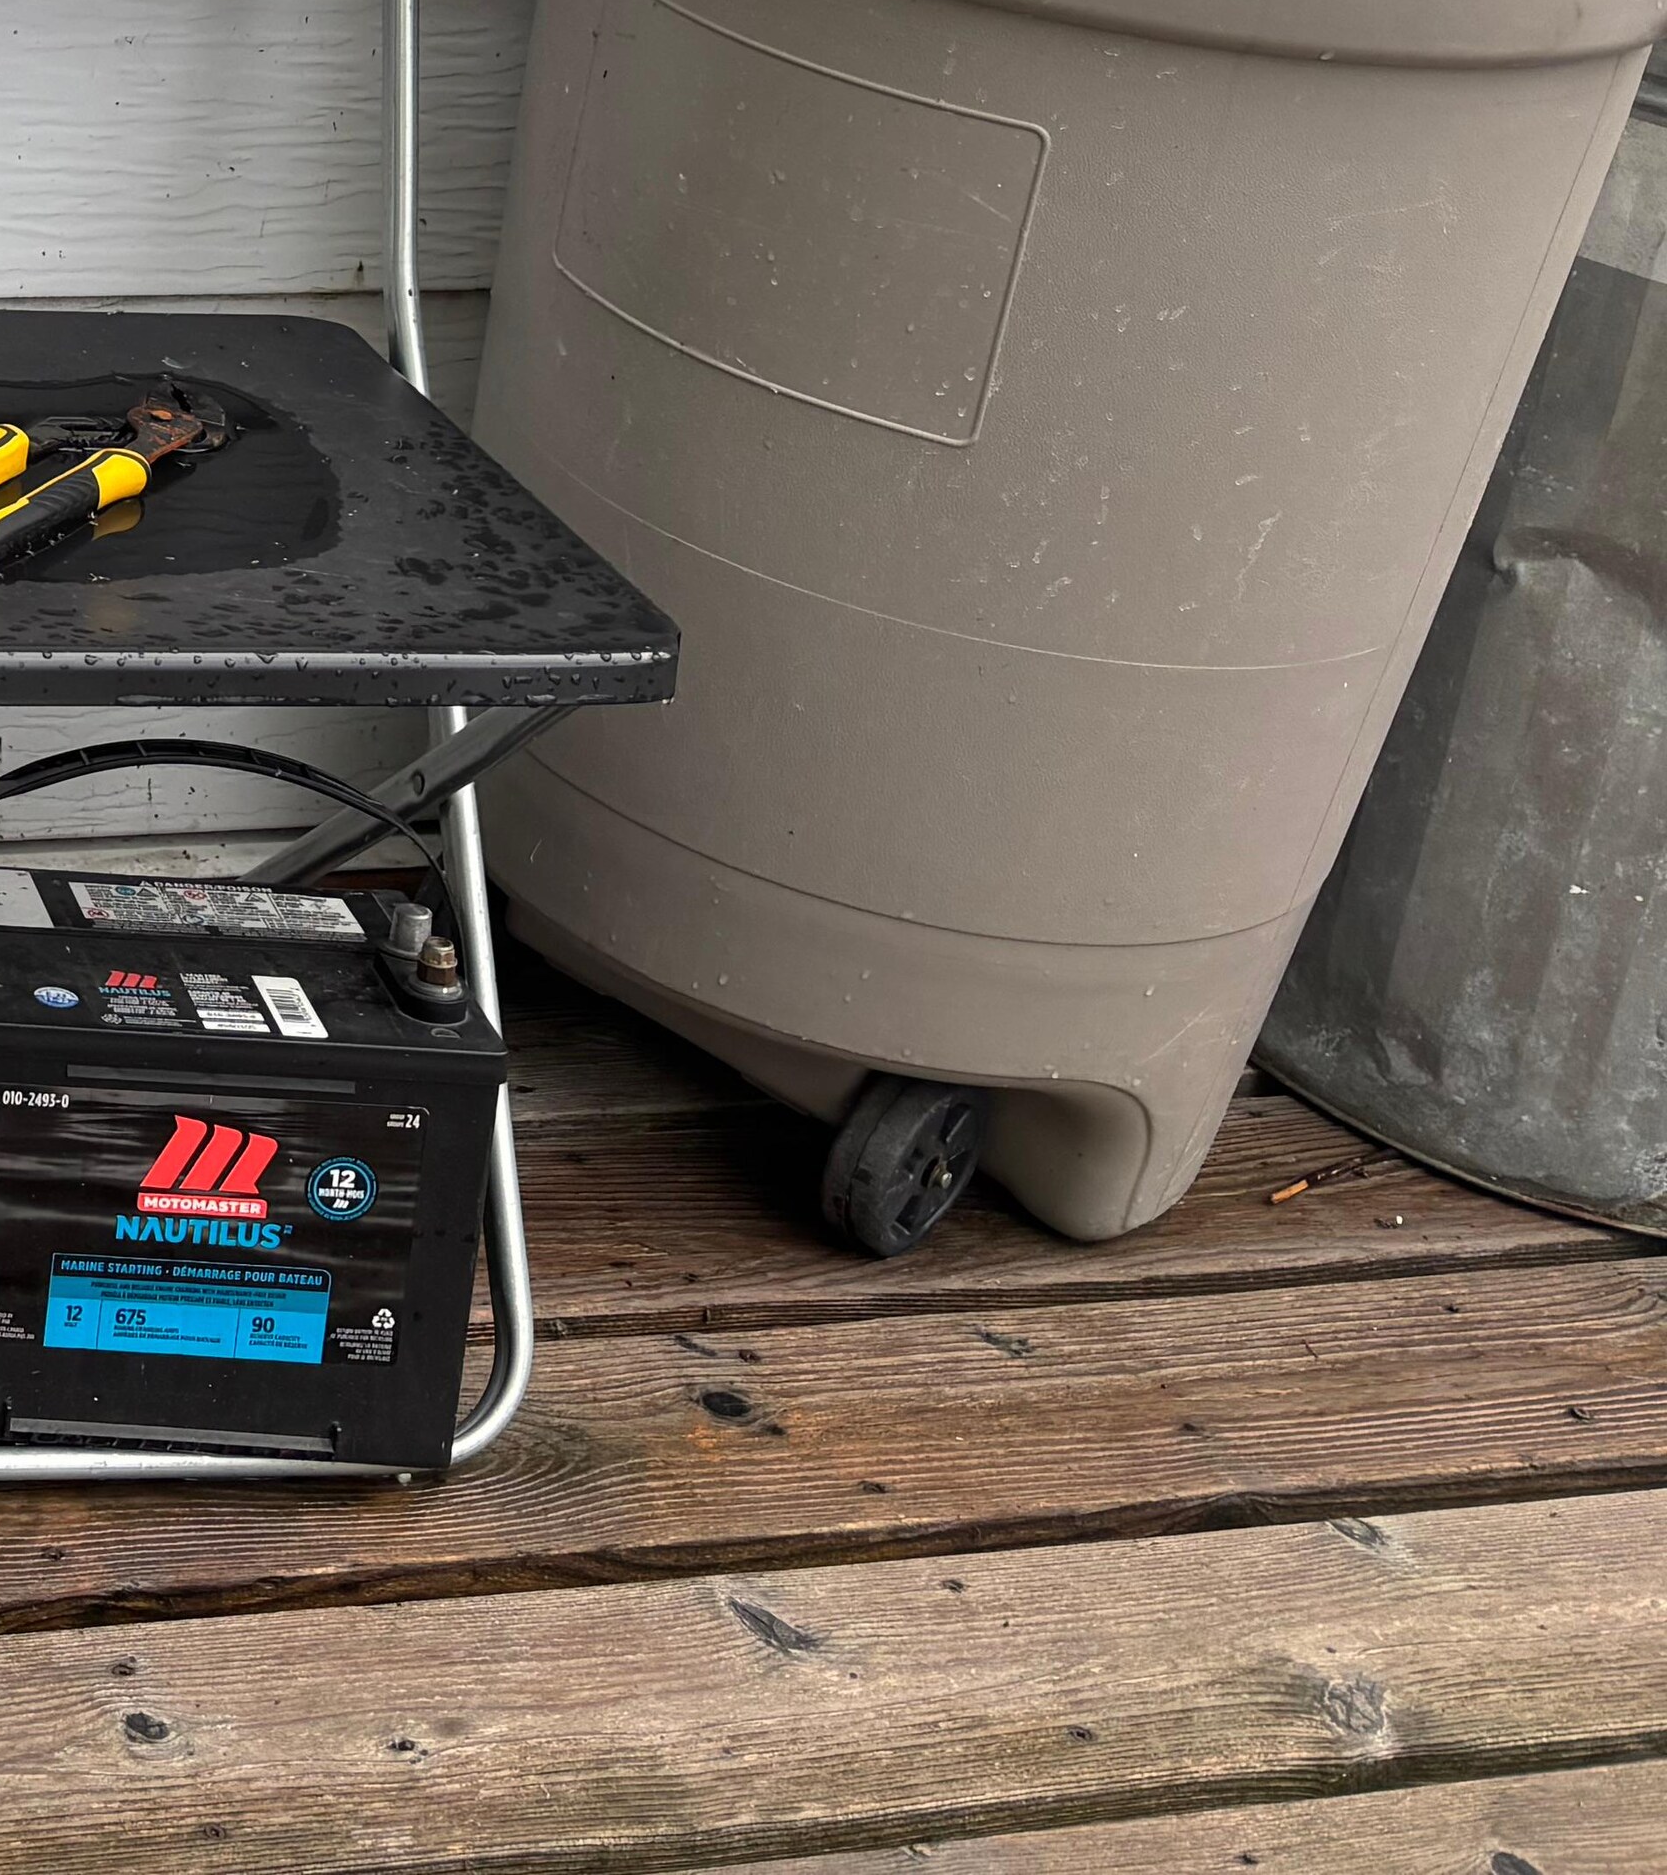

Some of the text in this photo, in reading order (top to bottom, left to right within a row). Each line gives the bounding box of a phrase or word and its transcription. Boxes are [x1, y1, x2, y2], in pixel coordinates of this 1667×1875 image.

[98, 986, 171, 997] NAUTILUS
[2, 1090, 69, 1108] 010-2493-0
[405, 1114, 420, 1129] 24
[330, 1169, 356, 1188] 12
[143, 1196, 261, 1215] MOTOMASTER
[115, 1215, 282, 1249] NAUTILUS
[61, 1260, 323, 1285] MARINE STARTING DÉMARRAGE POUR BATEAU
[66, 1305, 83, 1322] 12
[115, 1308, 146, 1325] 675
[252, 1316, 275, 1333] 90
